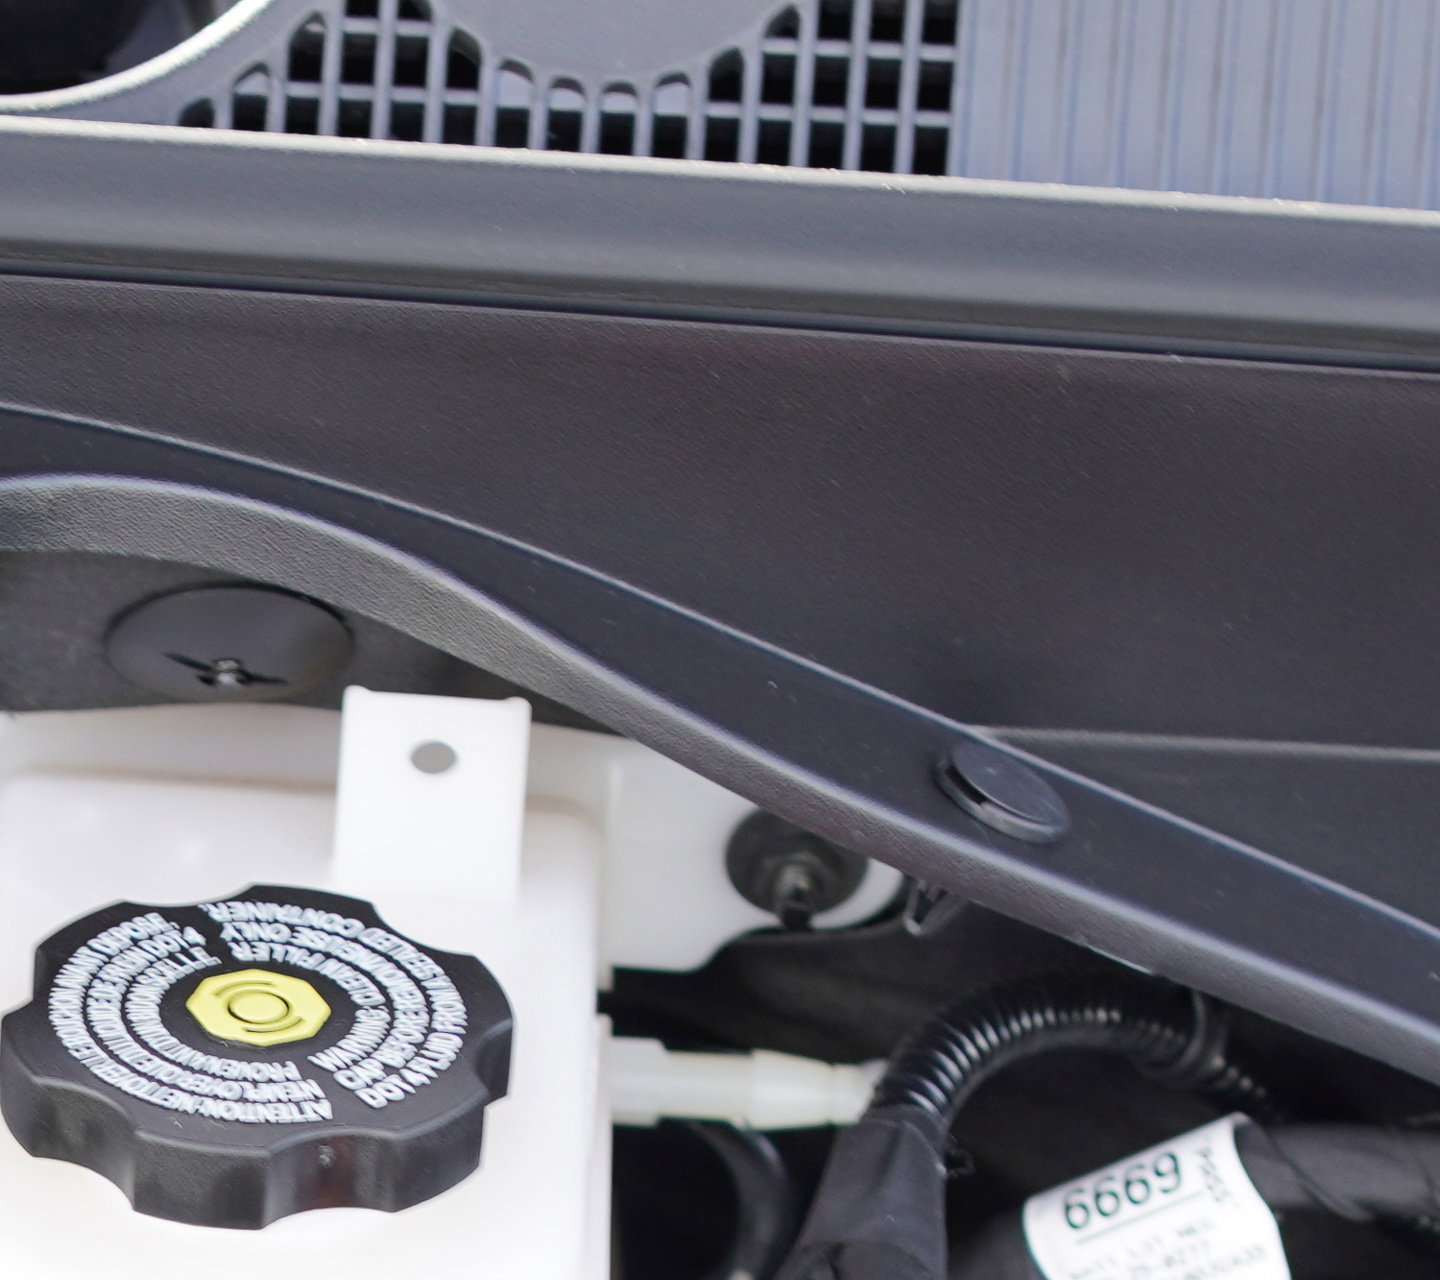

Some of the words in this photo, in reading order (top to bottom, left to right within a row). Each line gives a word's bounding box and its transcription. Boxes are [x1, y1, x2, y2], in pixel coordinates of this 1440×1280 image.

[137, 929, 196, 960] DOT
[219, 921, 296, 944] ONLY
[288, 926, 348, 954] USE
[355, 927, 447, 981] SEALED
[53, 945, 114, 991] AVANT
[96, 945, 158, 986] FREIN
[227, 941, 326, 971] FILLER
[124, 983, 167, 1023] BIDON
[312, 957, 387, 1007] CLEAN
[48, 987, 97, 1050] BOUCHON
[86, 996, 135, 1046] LIQUIDE
[425, 987, 468, 1035] FROM
[154, 1040, 303, 1083] PROVENANT
[366, 1009, 429, 1069] BEFORE
[402, 1031, 464, 1079] FLUID
[87, 1058, 205, 1115] NETTOYER
[332, 1056, 390, 1093] CAP
[353, 1073, 418, 1109] DOT
[1063, 1152, 1183, 1231] 6669
